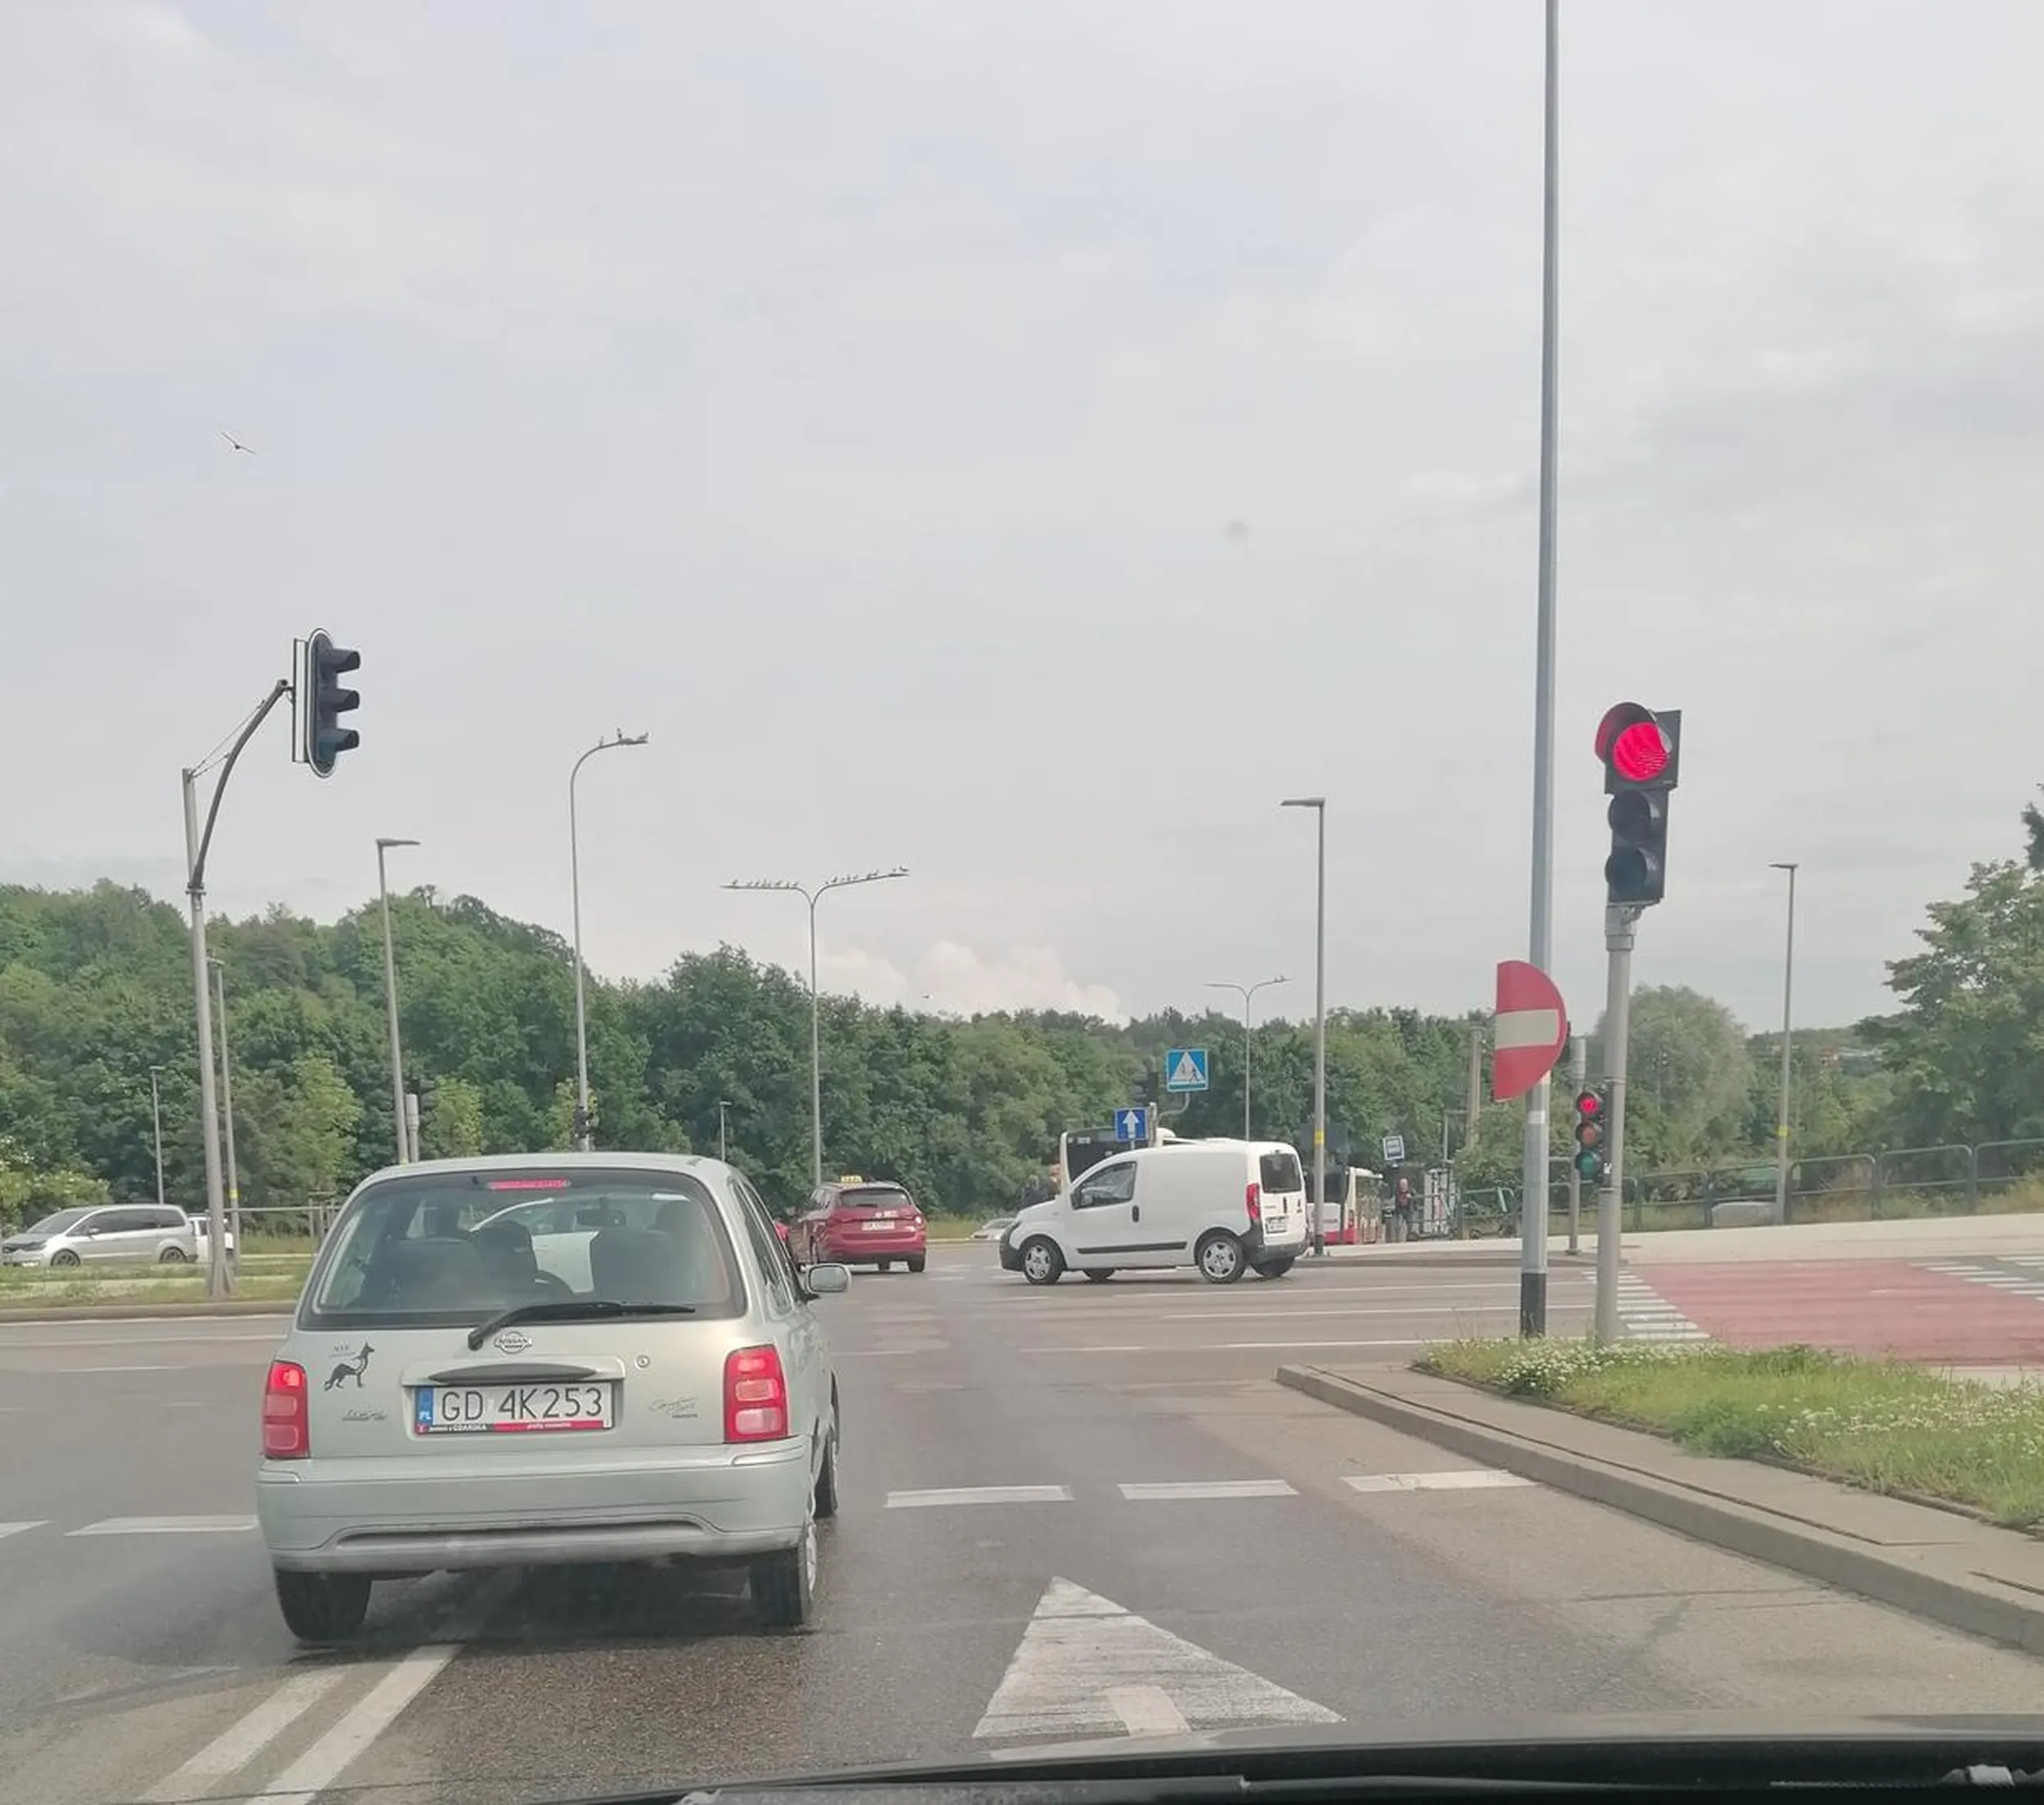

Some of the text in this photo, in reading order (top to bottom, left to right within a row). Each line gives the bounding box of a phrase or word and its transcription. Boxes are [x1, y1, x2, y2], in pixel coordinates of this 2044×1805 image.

[495, 1337, 531, 1346] NISSAN
[442, 1386, 603, 1422] GD 4K253
